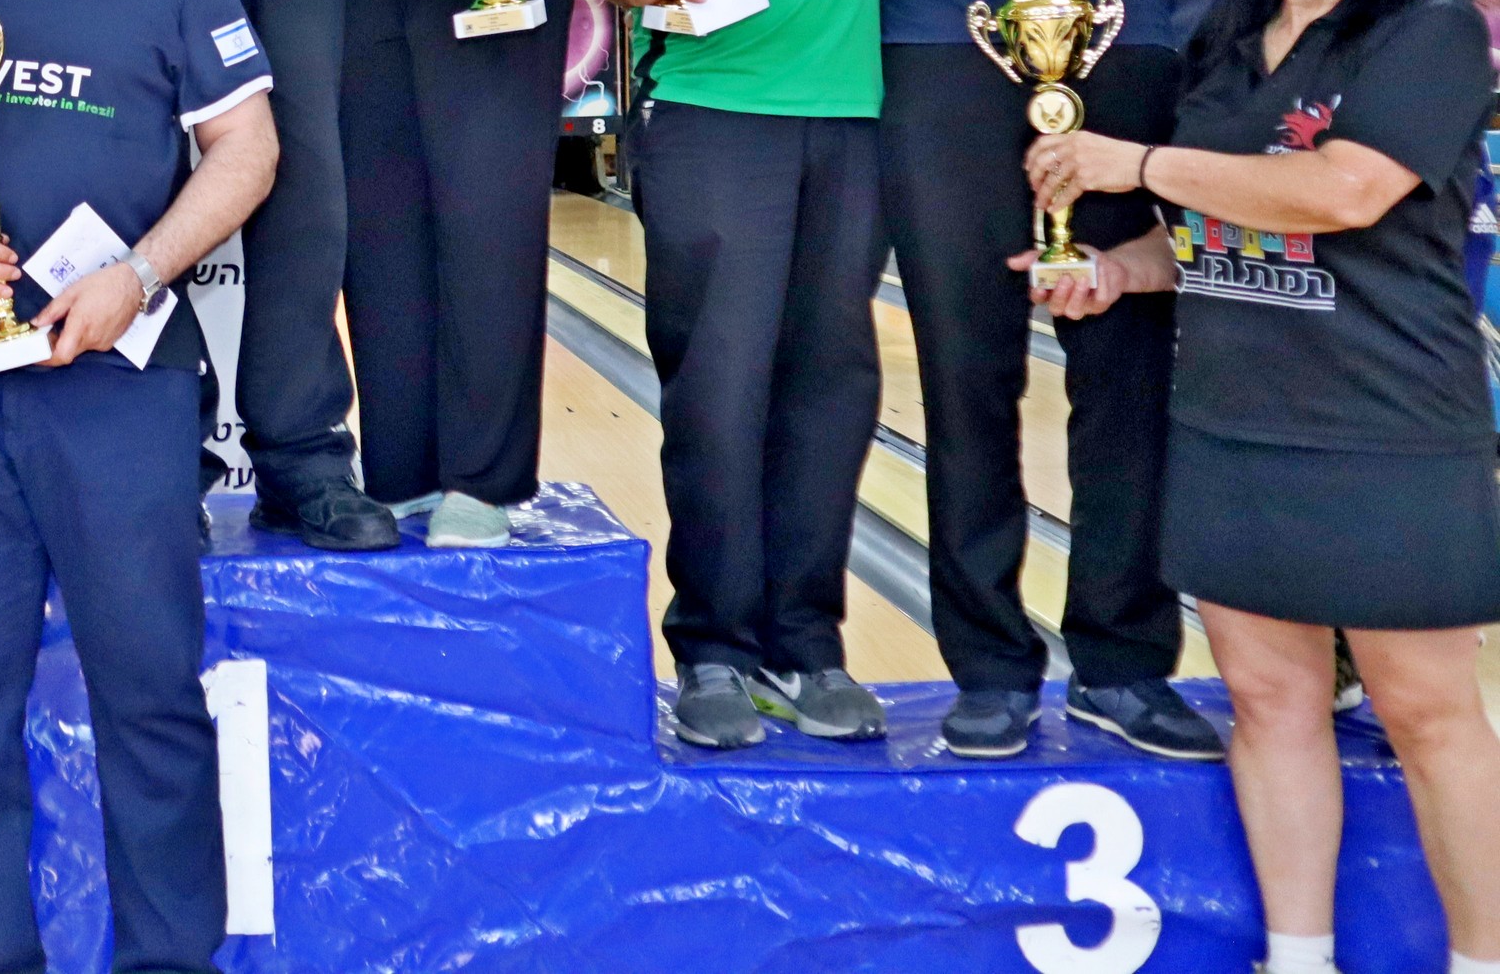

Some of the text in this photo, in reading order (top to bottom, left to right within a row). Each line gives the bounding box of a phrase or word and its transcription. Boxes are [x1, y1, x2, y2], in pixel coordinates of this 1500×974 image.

[6, 92, 58, 108] investor
[60, 98, 74, 110] in
[77, 100, 116, 119] Brazil
[592, 118, 607, 135] 8
[199, 659, 276, 935] 1
[1013, 782, 1162, 974] 3
